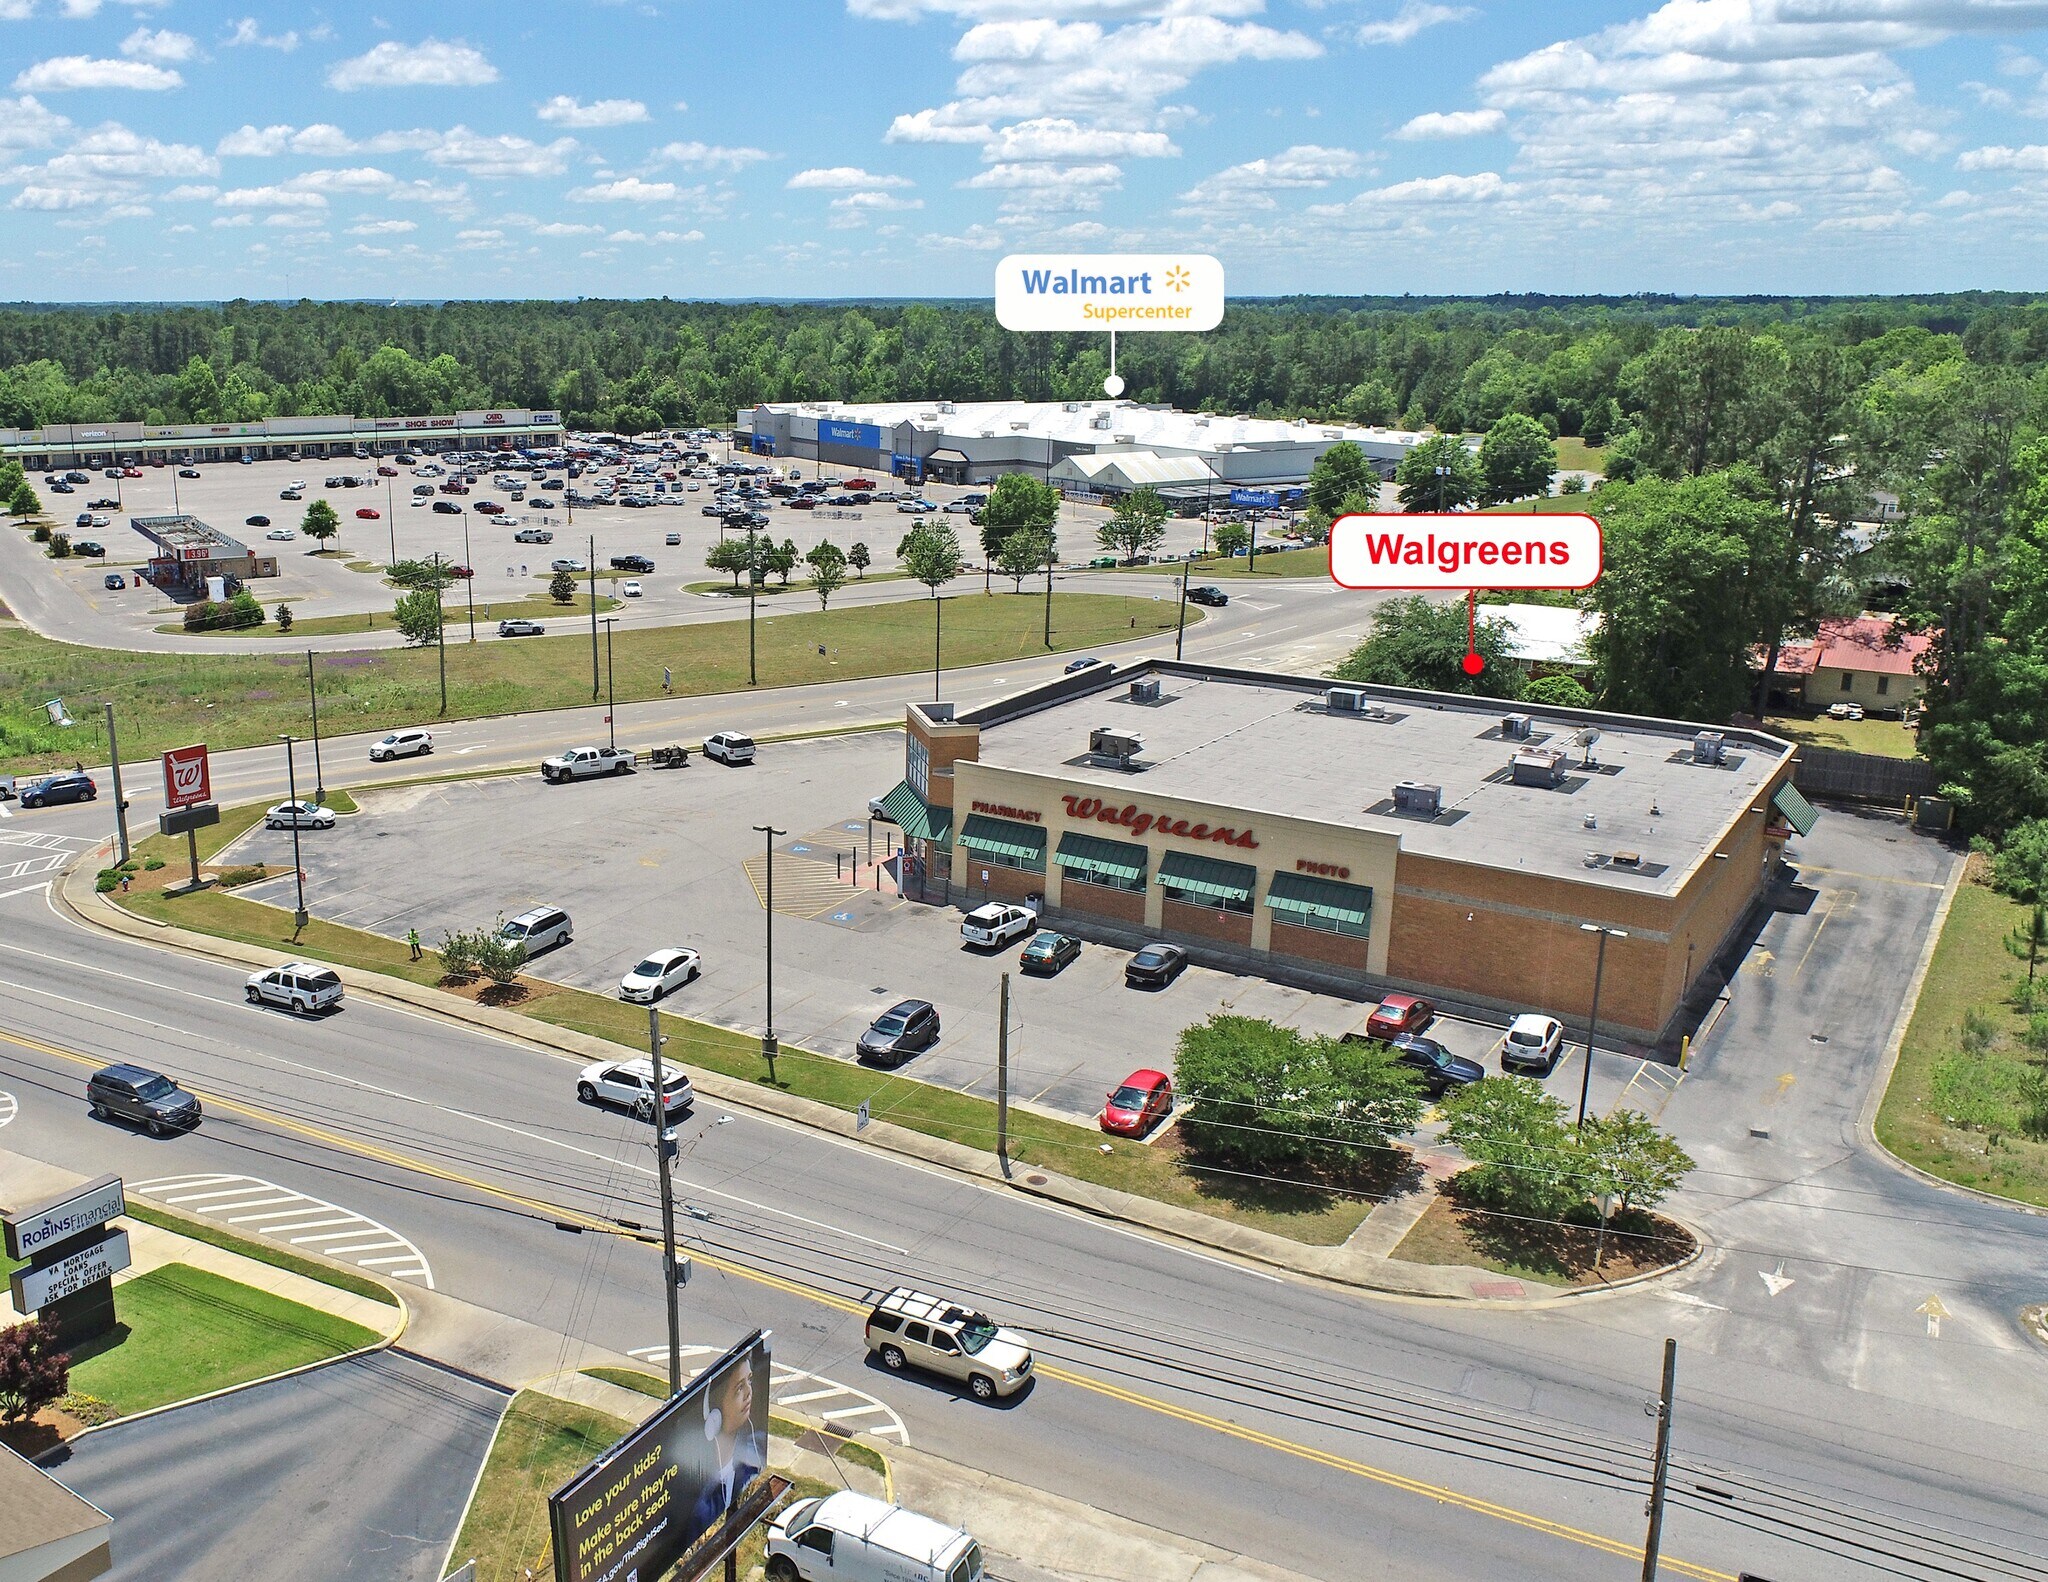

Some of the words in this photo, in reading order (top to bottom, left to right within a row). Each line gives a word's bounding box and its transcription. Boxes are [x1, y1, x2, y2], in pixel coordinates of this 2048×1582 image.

[80, 430, 107, 438] verizon
[405, 420, 427, 428] SHOE
[431, 419, 455, 427] SHOW
[831, 426, 854, 440] Walmart
[1235, 491, 1266, 505] Walmart
[173, 792, 207, 804] Walgreens
[972, 800, 1043, 823] PHARMACY
[1061, 794, 1260, 849] Walgreens
[1297, 859, 1350, 879] PHOTO
[71, 1216, 97, 1232] CREDIT
[100, 1208, 121, 1220] UNION
[48, 1267, 60, 1276] VA
[63, 1244, 104, 1269] MORTGAGE
[63, 1262, 89, 1277] LOANS
[44, 1294, 59, 1304] ASK
[63, 1283, 78, 1294] FOR
[82, 1266, 113, 1287] DETAILS
[48, 1274, 80, 1293] SPECIAL
[84, 1261, 107, 1276] OFFER
[575, 1498, 603, 1529] Love
[605, 1472, 632, 1506] your
[633, 1444, 662, 1479] kids?
[579, 1522, 612, 1559] Make
[614, 1498, 639, 1527] sure
[641, 1464, 678, 1503] they're
[580, 1561, 591, 1580] in
[593, 1541, 613, 1566] the
[616, 1513, 644, 1547] back
[645, 1490, 671, 1520] seat.
